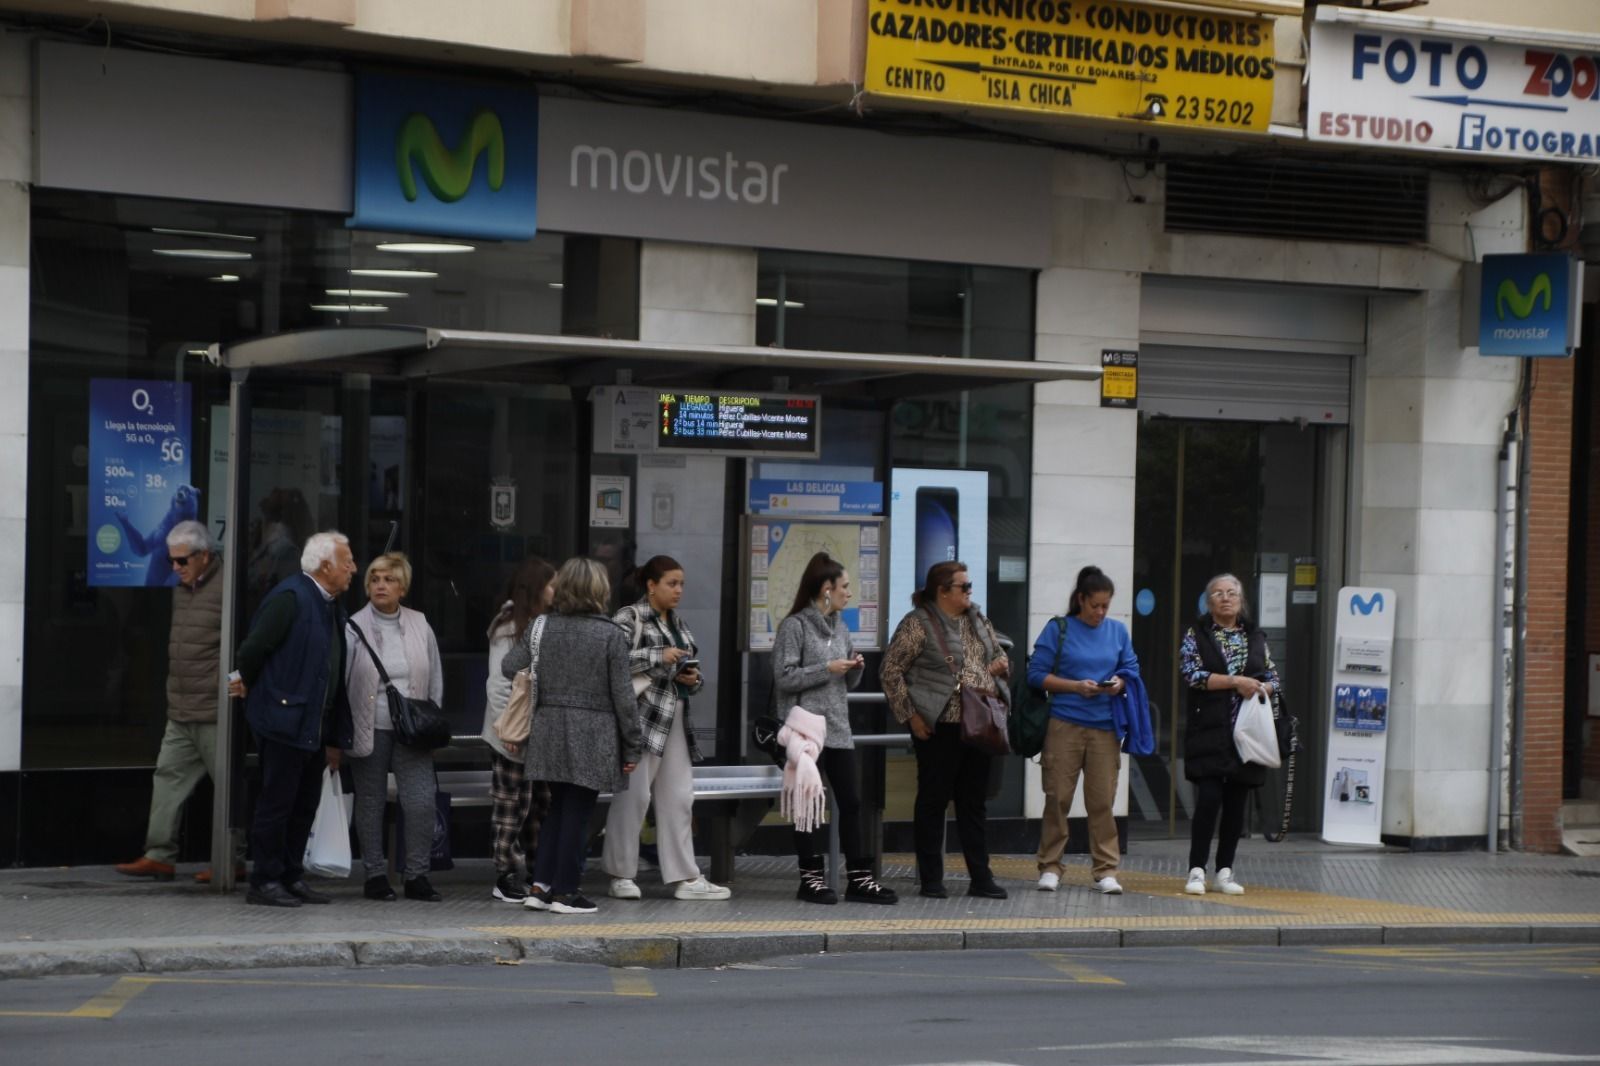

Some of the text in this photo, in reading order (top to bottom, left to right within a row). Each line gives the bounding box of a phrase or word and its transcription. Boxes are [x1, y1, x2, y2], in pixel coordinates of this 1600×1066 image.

[1086, 4, 1261, 47] CONDUCTORES
[870, 11, 1007, 51] CAZADORES
[1014, 29, 1168, 70] CERTIFICADOS
[993, 55, 1043, 70] ENTRADA
[1048, 61, 1069, 73] POR
[1088, 66, 1135, 81] BONARES
[1352, 34, 1487, 90] FOTO
[885, 66, 945, 92] CENTRO
[1319, 111, 1433, 144] ESTUDIO
[569, 144, 788, 205] movistar
[1494, 327, 1550, 340] movistar
[684, 394, 710, 403] TIEMPO
[680, 403, 713, 411] LLEGANDO
[663, 410, 669, 418] 4
[689, 411, 714, 419] minutos
[785, 414, 808, 423] Mortes
[682, 419, 695, 427] bus
[105, 420, 126, 431] Llega
[127, 421, 135, 430] la
[126, 433, 137, 442] 5G
[663, 427, 669, 435] 4
[682, 427, 695, 435] bus
[784, 430, 808, 439] Mortes
[161, 441, 184, 462] 5G
[787, 481, 846, 494] LAS DELICIAS
[771, 496, 778, 507] 2
[781, 497, 788, 507] 4
